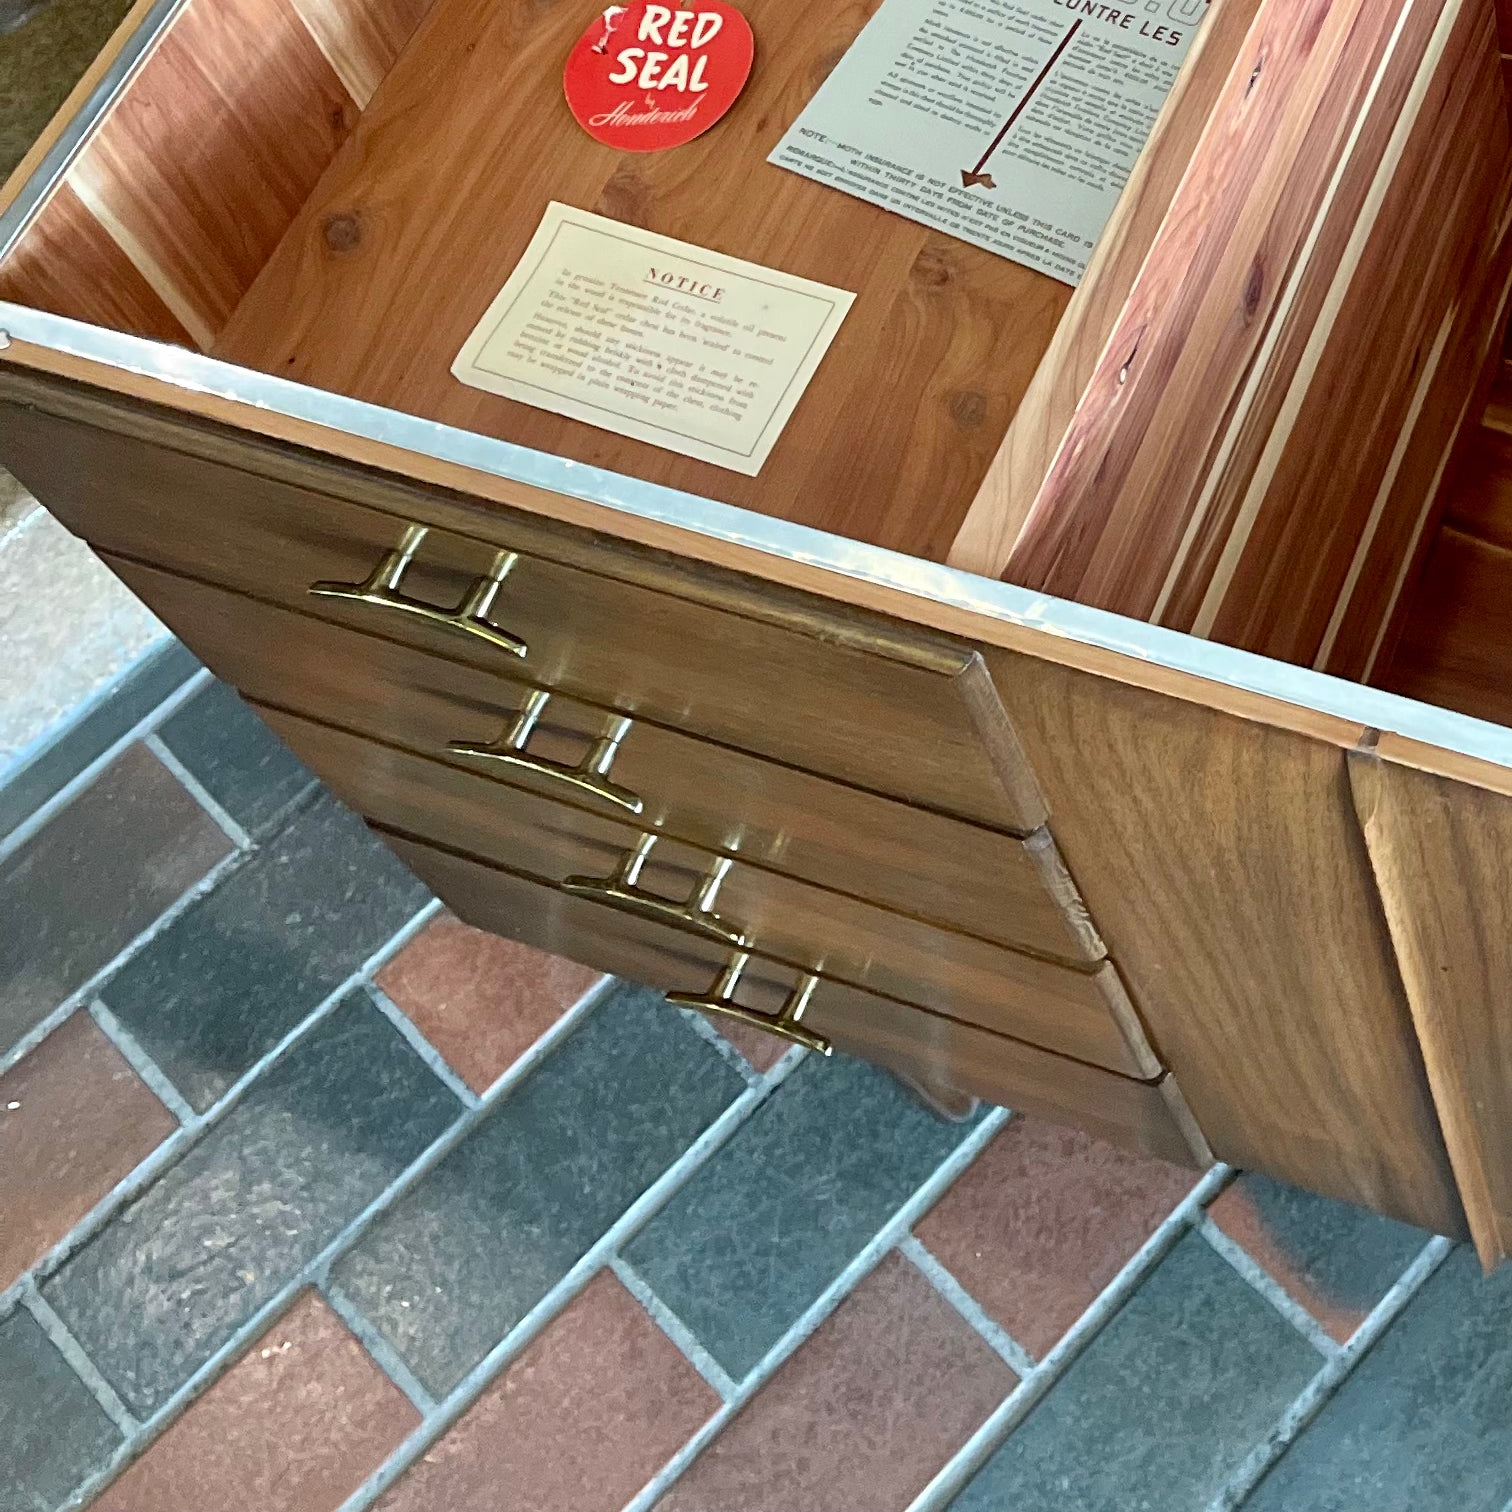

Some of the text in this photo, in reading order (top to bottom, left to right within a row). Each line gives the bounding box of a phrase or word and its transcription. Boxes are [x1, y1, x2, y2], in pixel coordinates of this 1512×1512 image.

[638, 4, 723, 49] RED
[1138, 21, 1183, 47] LES
[608, 47, 708, 93] SEAL
[863, 152, 914, 177] INSURANCE
[926, 176, 947, 190] NOT
[1053, 226, 1081, 243] CARD
[882, 171, 917, 189] THIRTY
[918, 185, 944, 200] DAYS
[945, 195, 973, 211] FROM
[975, 207, 1000, 222] DATE
[645, 267, 726, 301] NOTICE
